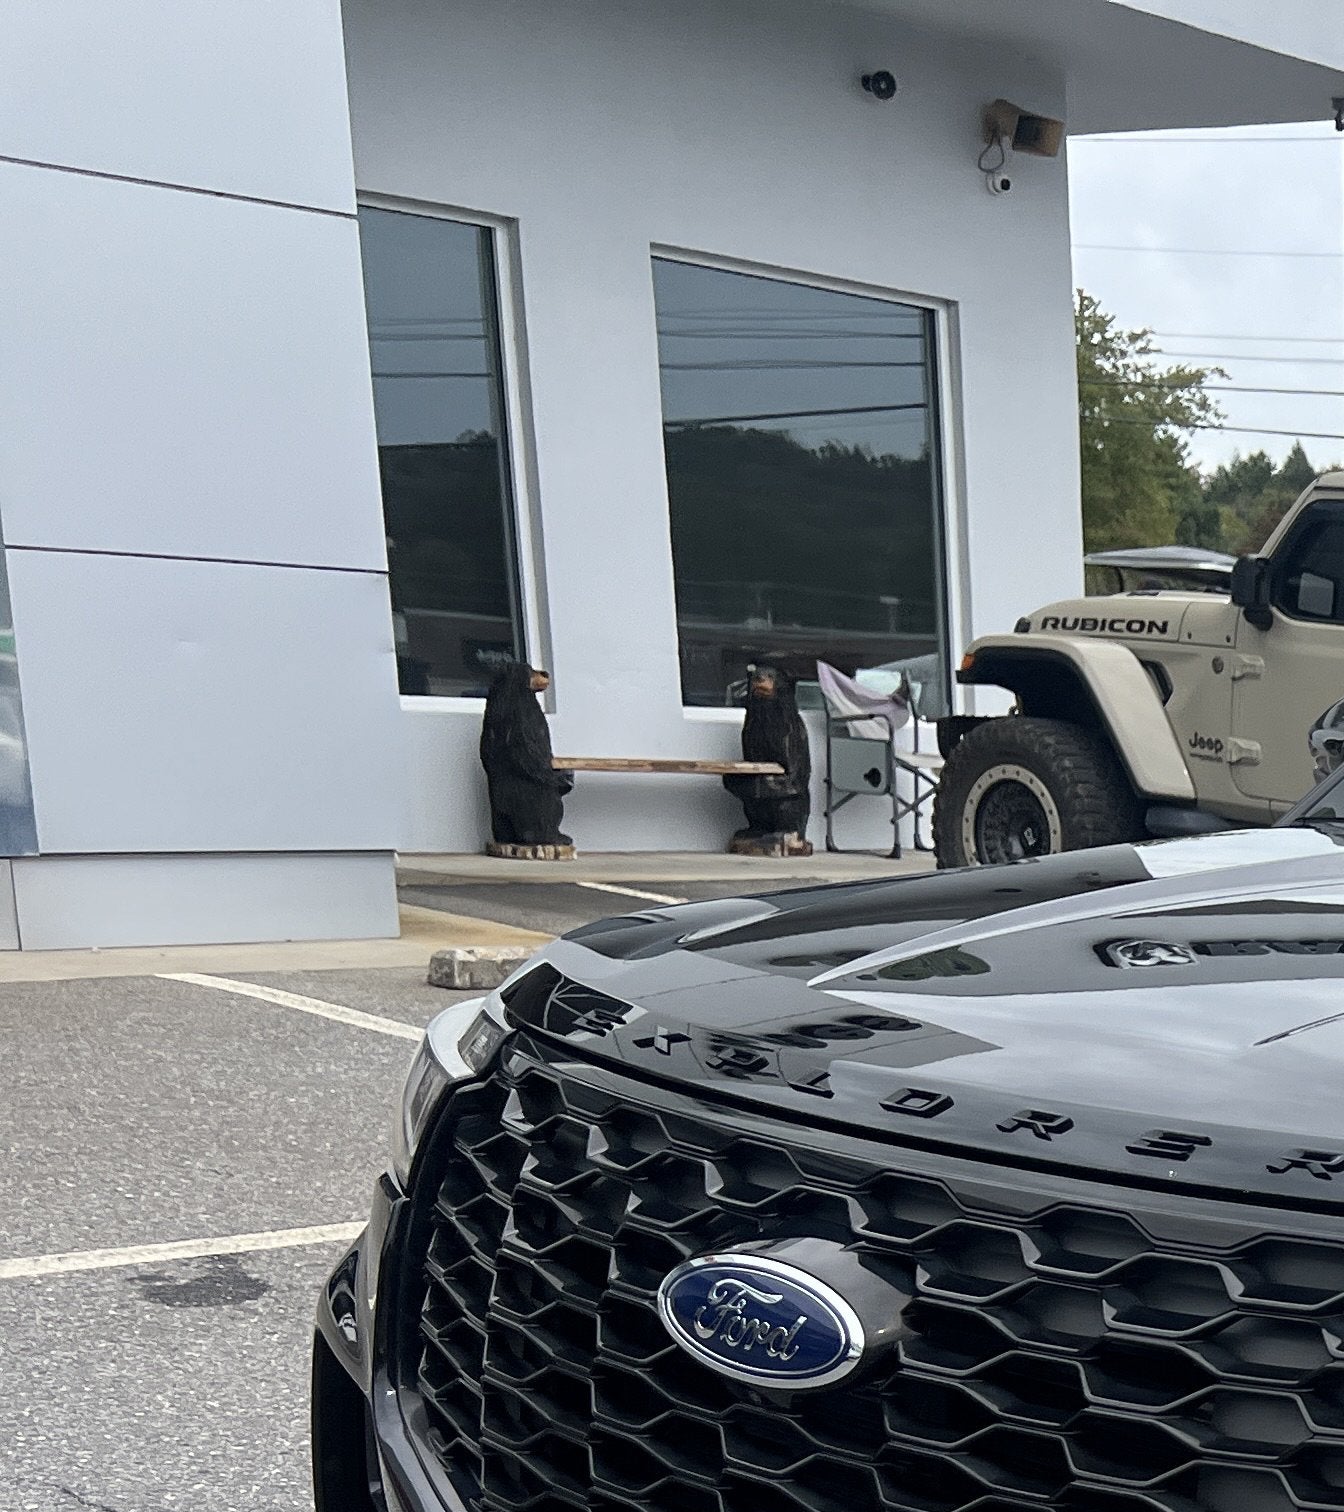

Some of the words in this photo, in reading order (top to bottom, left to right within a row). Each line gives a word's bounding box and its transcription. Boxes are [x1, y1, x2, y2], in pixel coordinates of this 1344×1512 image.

[1041, 616, 1168, 634] RUBICON
[1189, 731, 1224, 753] Jeep
[693, 1278, 807, 1361] Ford
